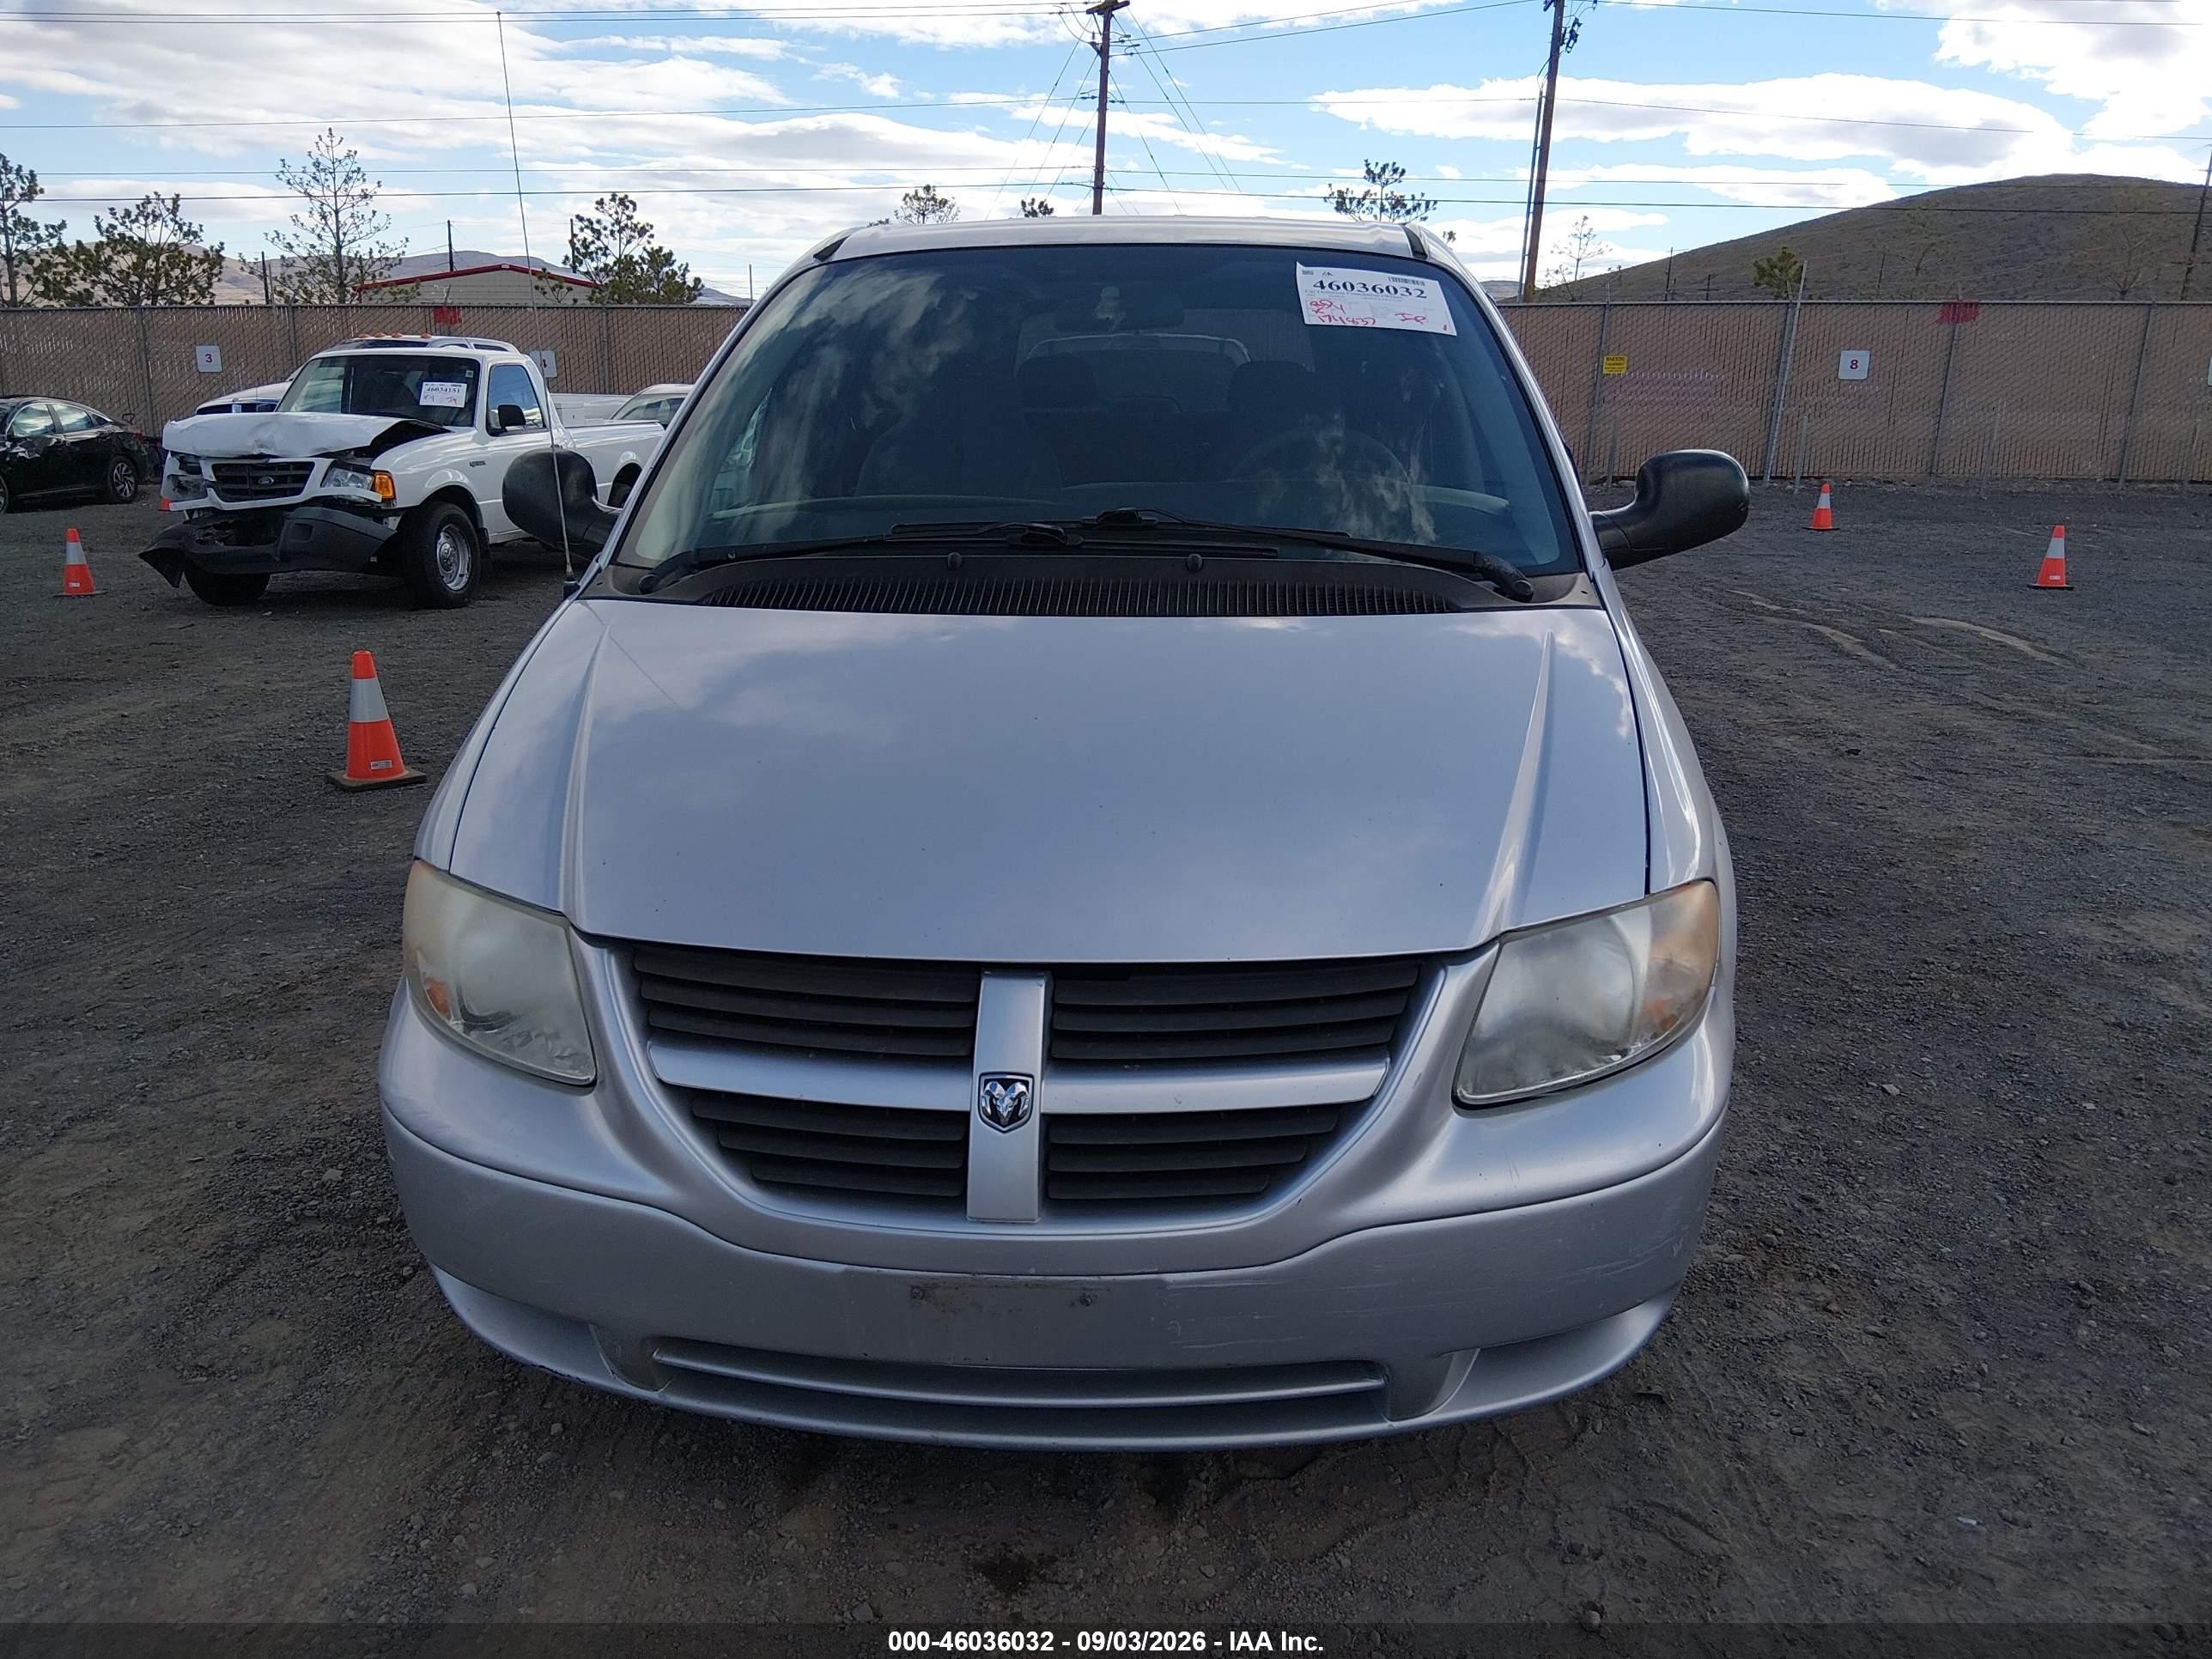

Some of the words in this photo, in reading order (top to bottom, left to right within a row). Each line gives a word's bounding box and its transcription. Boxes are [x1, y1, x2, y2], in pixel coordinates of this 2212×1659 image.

[1312, 280, 1427, 299] 46036032
[205, 353, 213, 363] 3
[1850, 359, 1858, 370] 8
